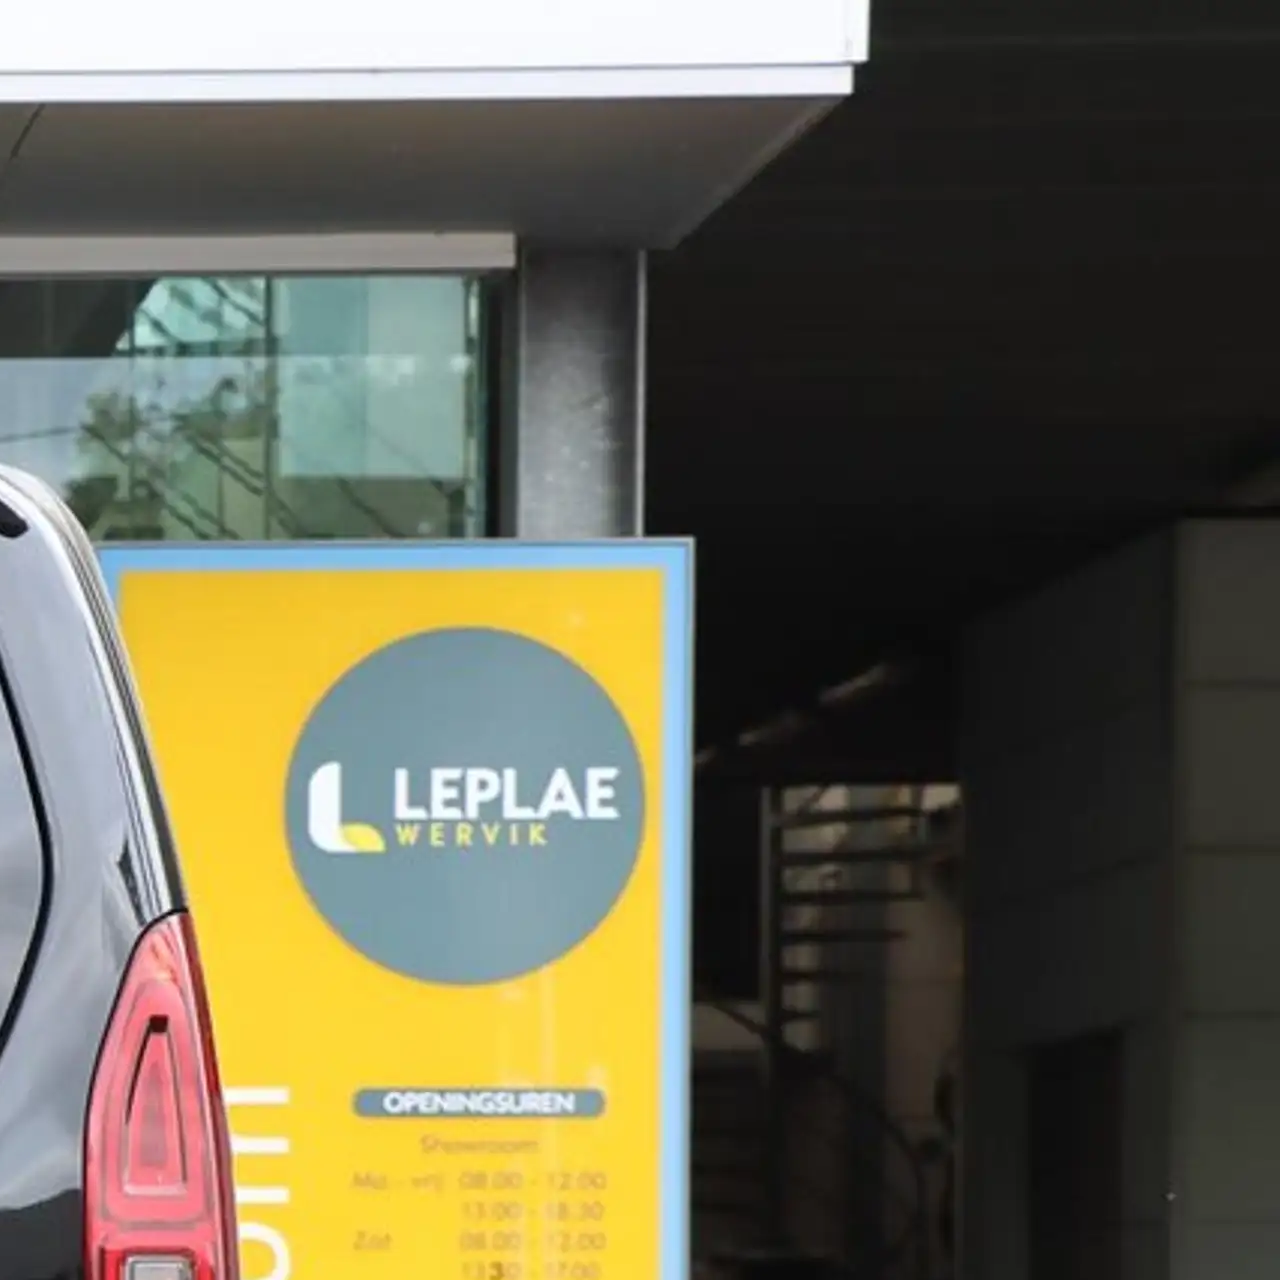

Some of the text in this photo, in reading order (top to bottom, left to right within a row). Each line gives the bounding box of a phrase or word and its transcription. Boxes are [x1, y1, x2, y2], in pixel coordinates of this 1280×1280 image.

[394, 767, 621, 819] LEPLAE
[395, 822, 548, 847] WERVIK
[382, 1092, 577, 1114] OPENINGSUREN
